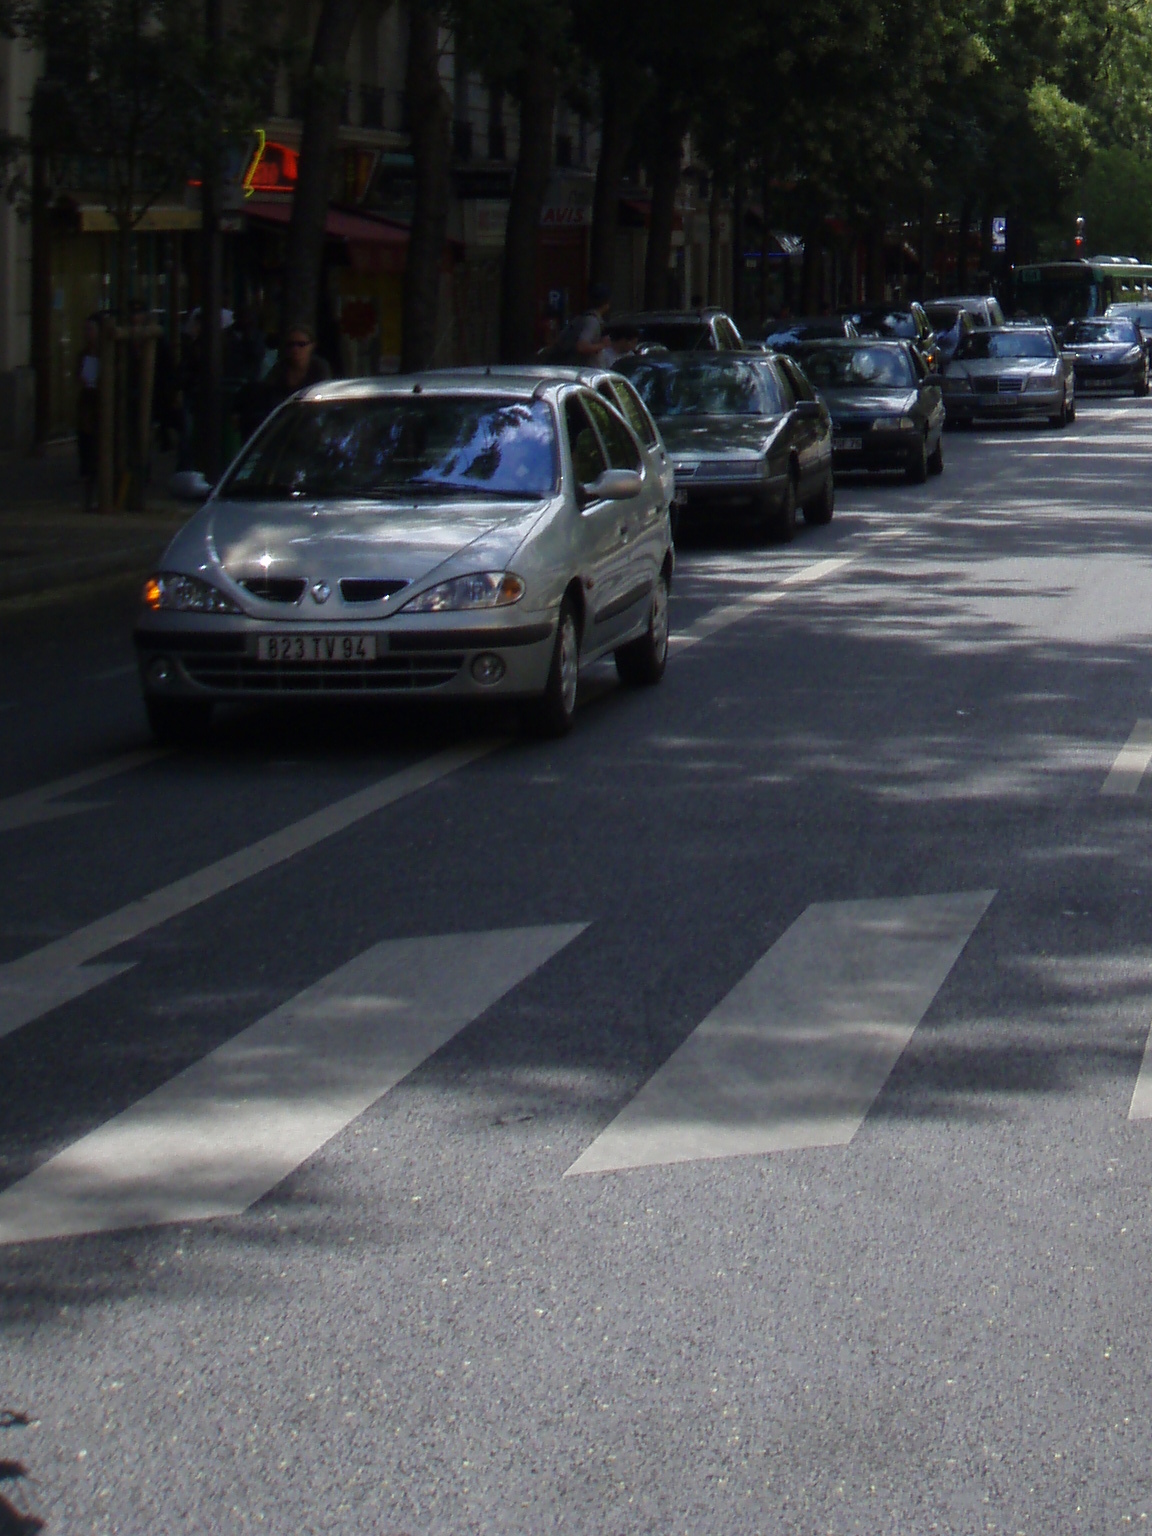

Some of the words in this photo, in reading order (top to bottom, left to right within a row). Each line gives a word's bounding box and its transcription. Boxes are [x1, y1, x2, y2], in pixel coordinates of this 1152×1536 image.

[543, 208, 584, 222] AVIS
[268, 637, 305, 659] 823
[313, 637, 336, 659] TV
[344, 637, 366, 658] 94
